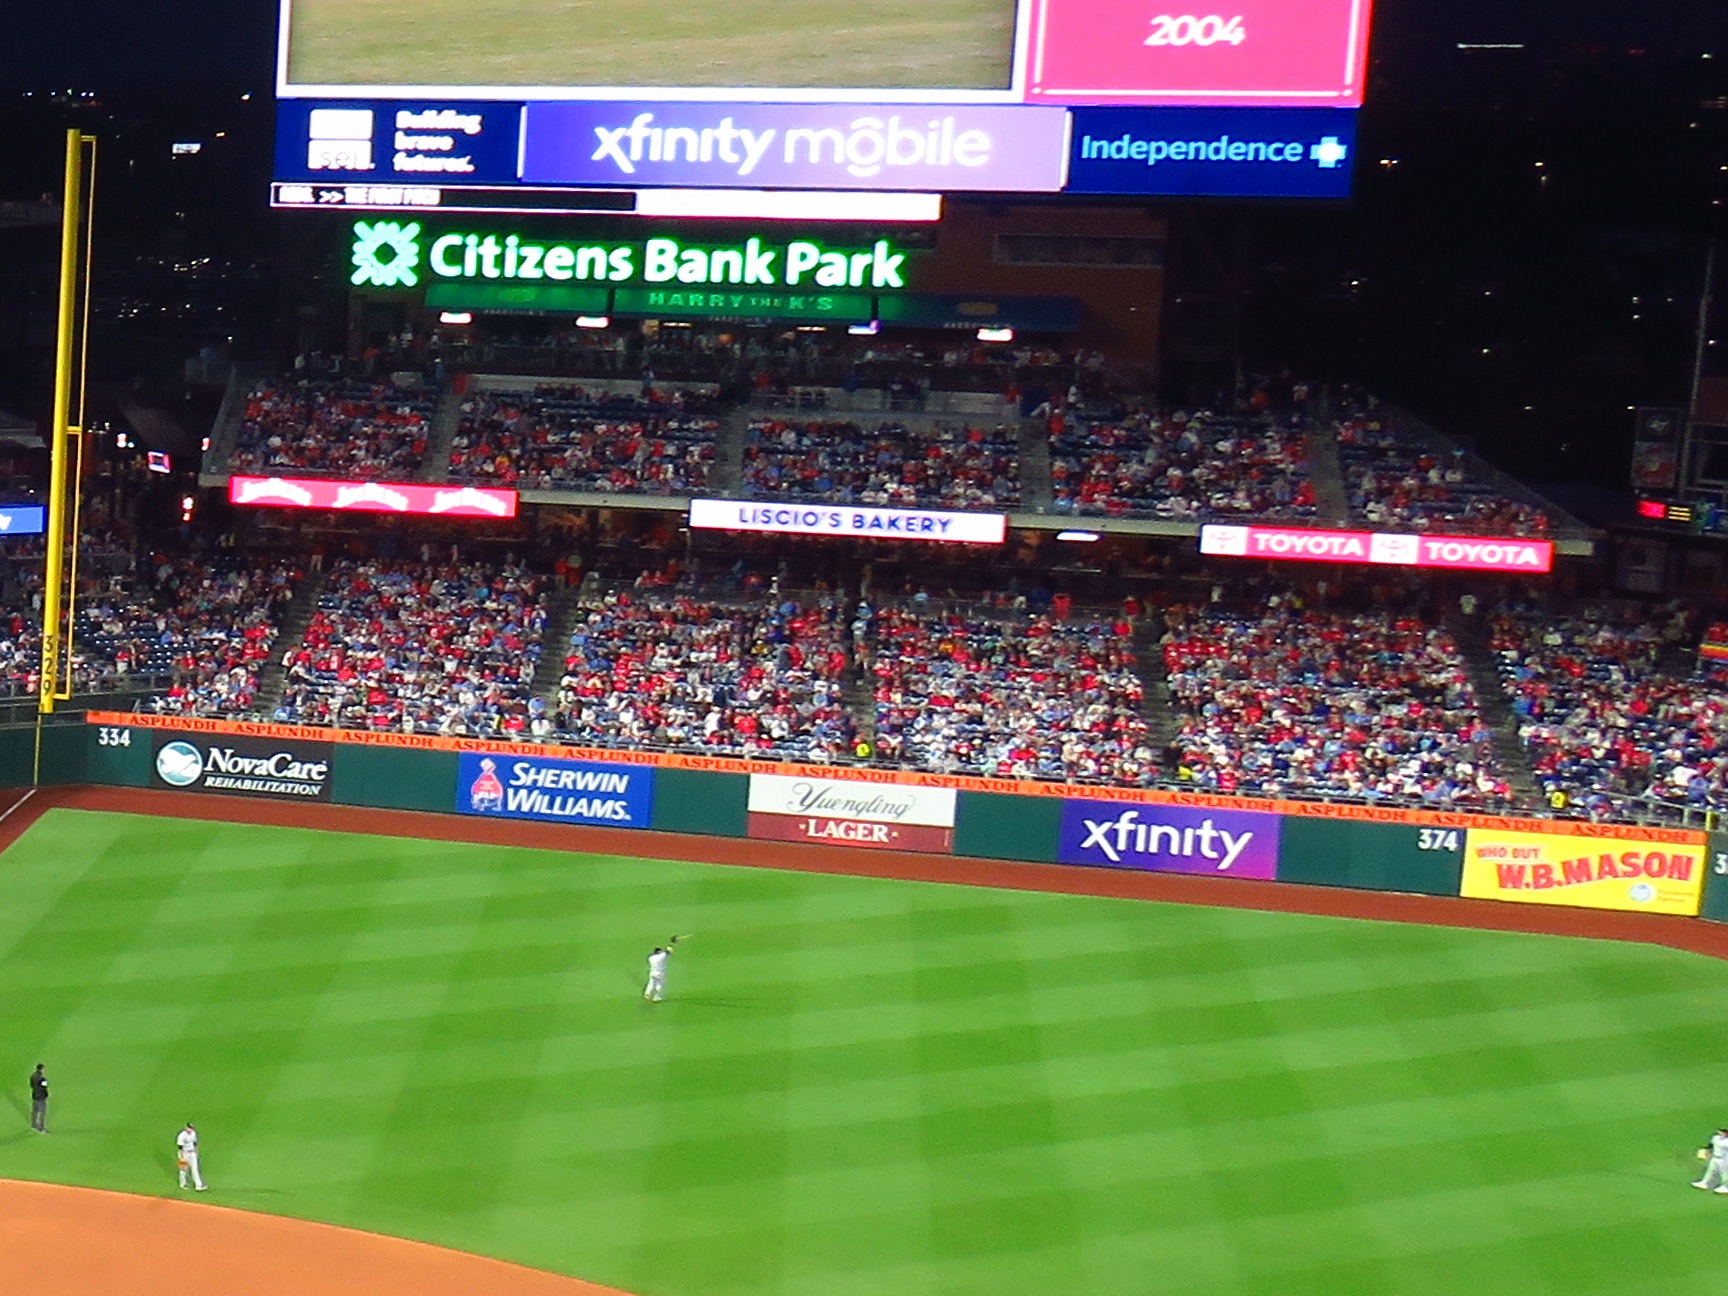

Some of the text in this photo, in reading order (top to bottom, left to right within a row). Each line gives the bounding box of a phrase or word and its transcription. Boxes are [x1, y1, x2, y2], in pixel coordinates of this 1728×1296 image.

[1143, 15, 1246, 47] 2004
[589, 113, 777, 174] xfinity
[1080, 134, 1304, 166] Independence
[428, 232, 908, 289] Citizens Bank Park
[648, 292, 743, 309] HARRY
[738, 507, 953, 534] LISCIO'S BAKERY
[1253, 533, 1363, 557] TOYOTA
[1426, 540, 1538, 566] TOYOTA
[130, 716, 217, 731] ASPLUNDH
[234, 723, 324, 740] ASPLUNDH
[98, 727, 131, 747] 334
[343, 731, 434, 748] ASPLUNDH
[452, 739, 546, 756] ASPLUNDH
[565, 747, 660, 765] ASPLUNDH
[204, 747, 328, 781] NovaCare
[679, 756, 777, 774] ASPLUNDH
[509, 762, 629, 795] SHERWIN
[798, 766, 897, 783] ASPLUNDH
[917, 774, 1020, 792] ASPLUNDH
[204, 776, 322, 796] REHABILITATION
[1042, 784, 1145, 802] ASPLUNDH
[791, 782, 915, 819] Yuengling
[1166, 792, 1275, 812] ASPLUNDH
[1295, 802, 1407, 822] ASPLUNDH
[1428, 812, 1543, 832] ASPLUNDH
[806, 818, 890, 844] LAGER
[1080, 810, 1253, 870] xfinity
[1418, 829, 1458, 852] 374
[1573, 823, 1689, 842] ASPLUNDH
